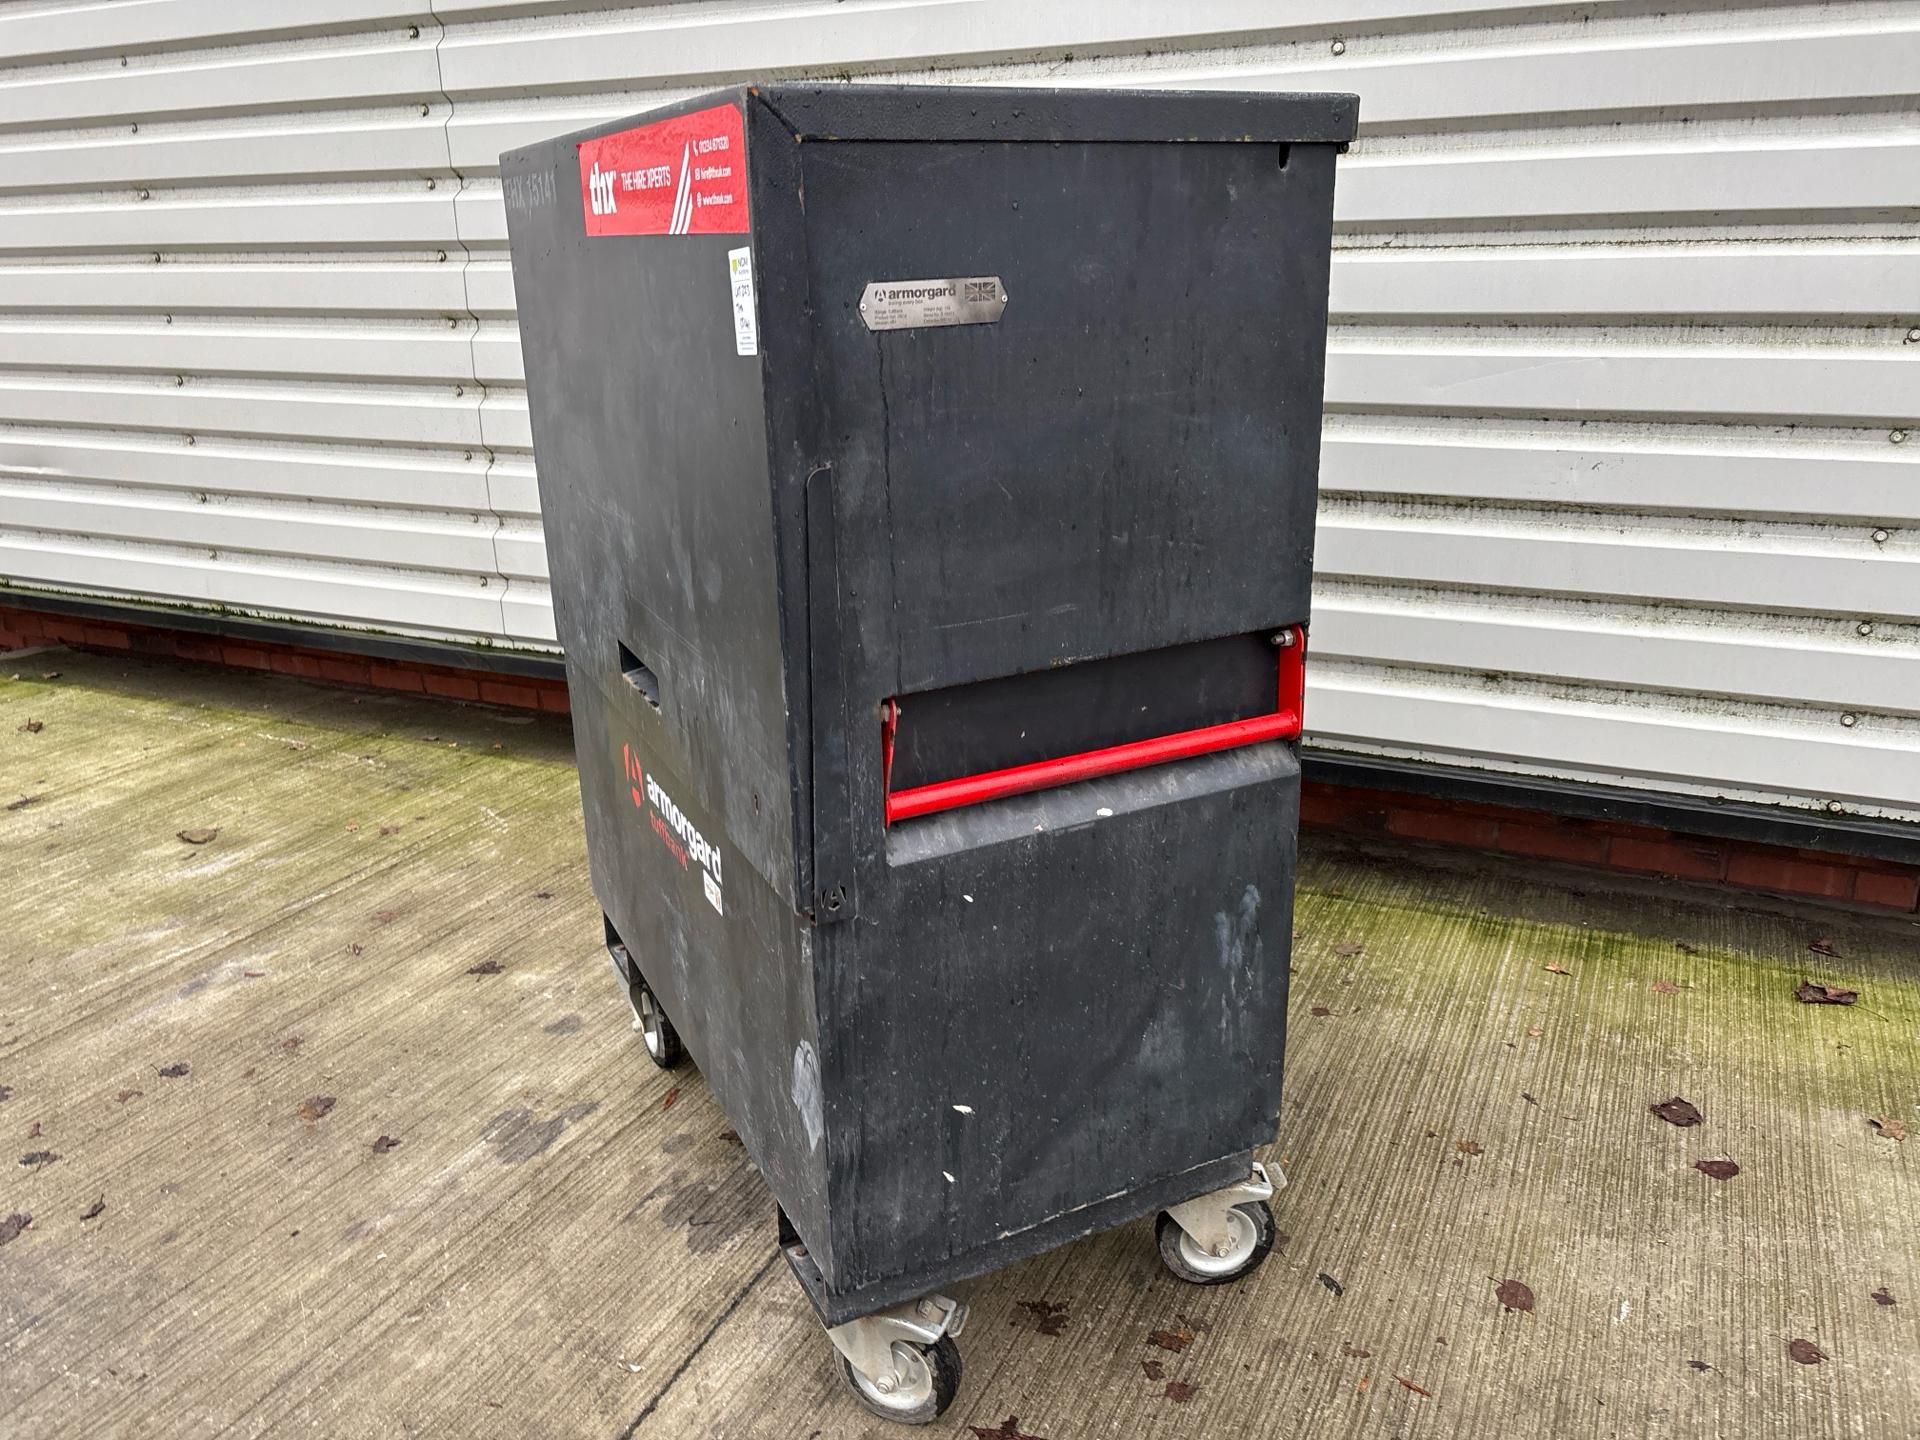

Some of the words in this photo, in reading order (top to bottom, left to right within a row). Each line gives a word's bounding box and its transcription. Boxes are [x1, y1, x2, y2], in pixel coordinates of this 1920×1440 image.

[589, 161, 618, 215] thx
[621, 171, 633, 192] THE
[633, 169, 647, 190] HIRE
[647, 165, 672, 189] XPERTS
[889, 286, 956, 300] armorgard
[646, 773, 723, 883] armorgard
